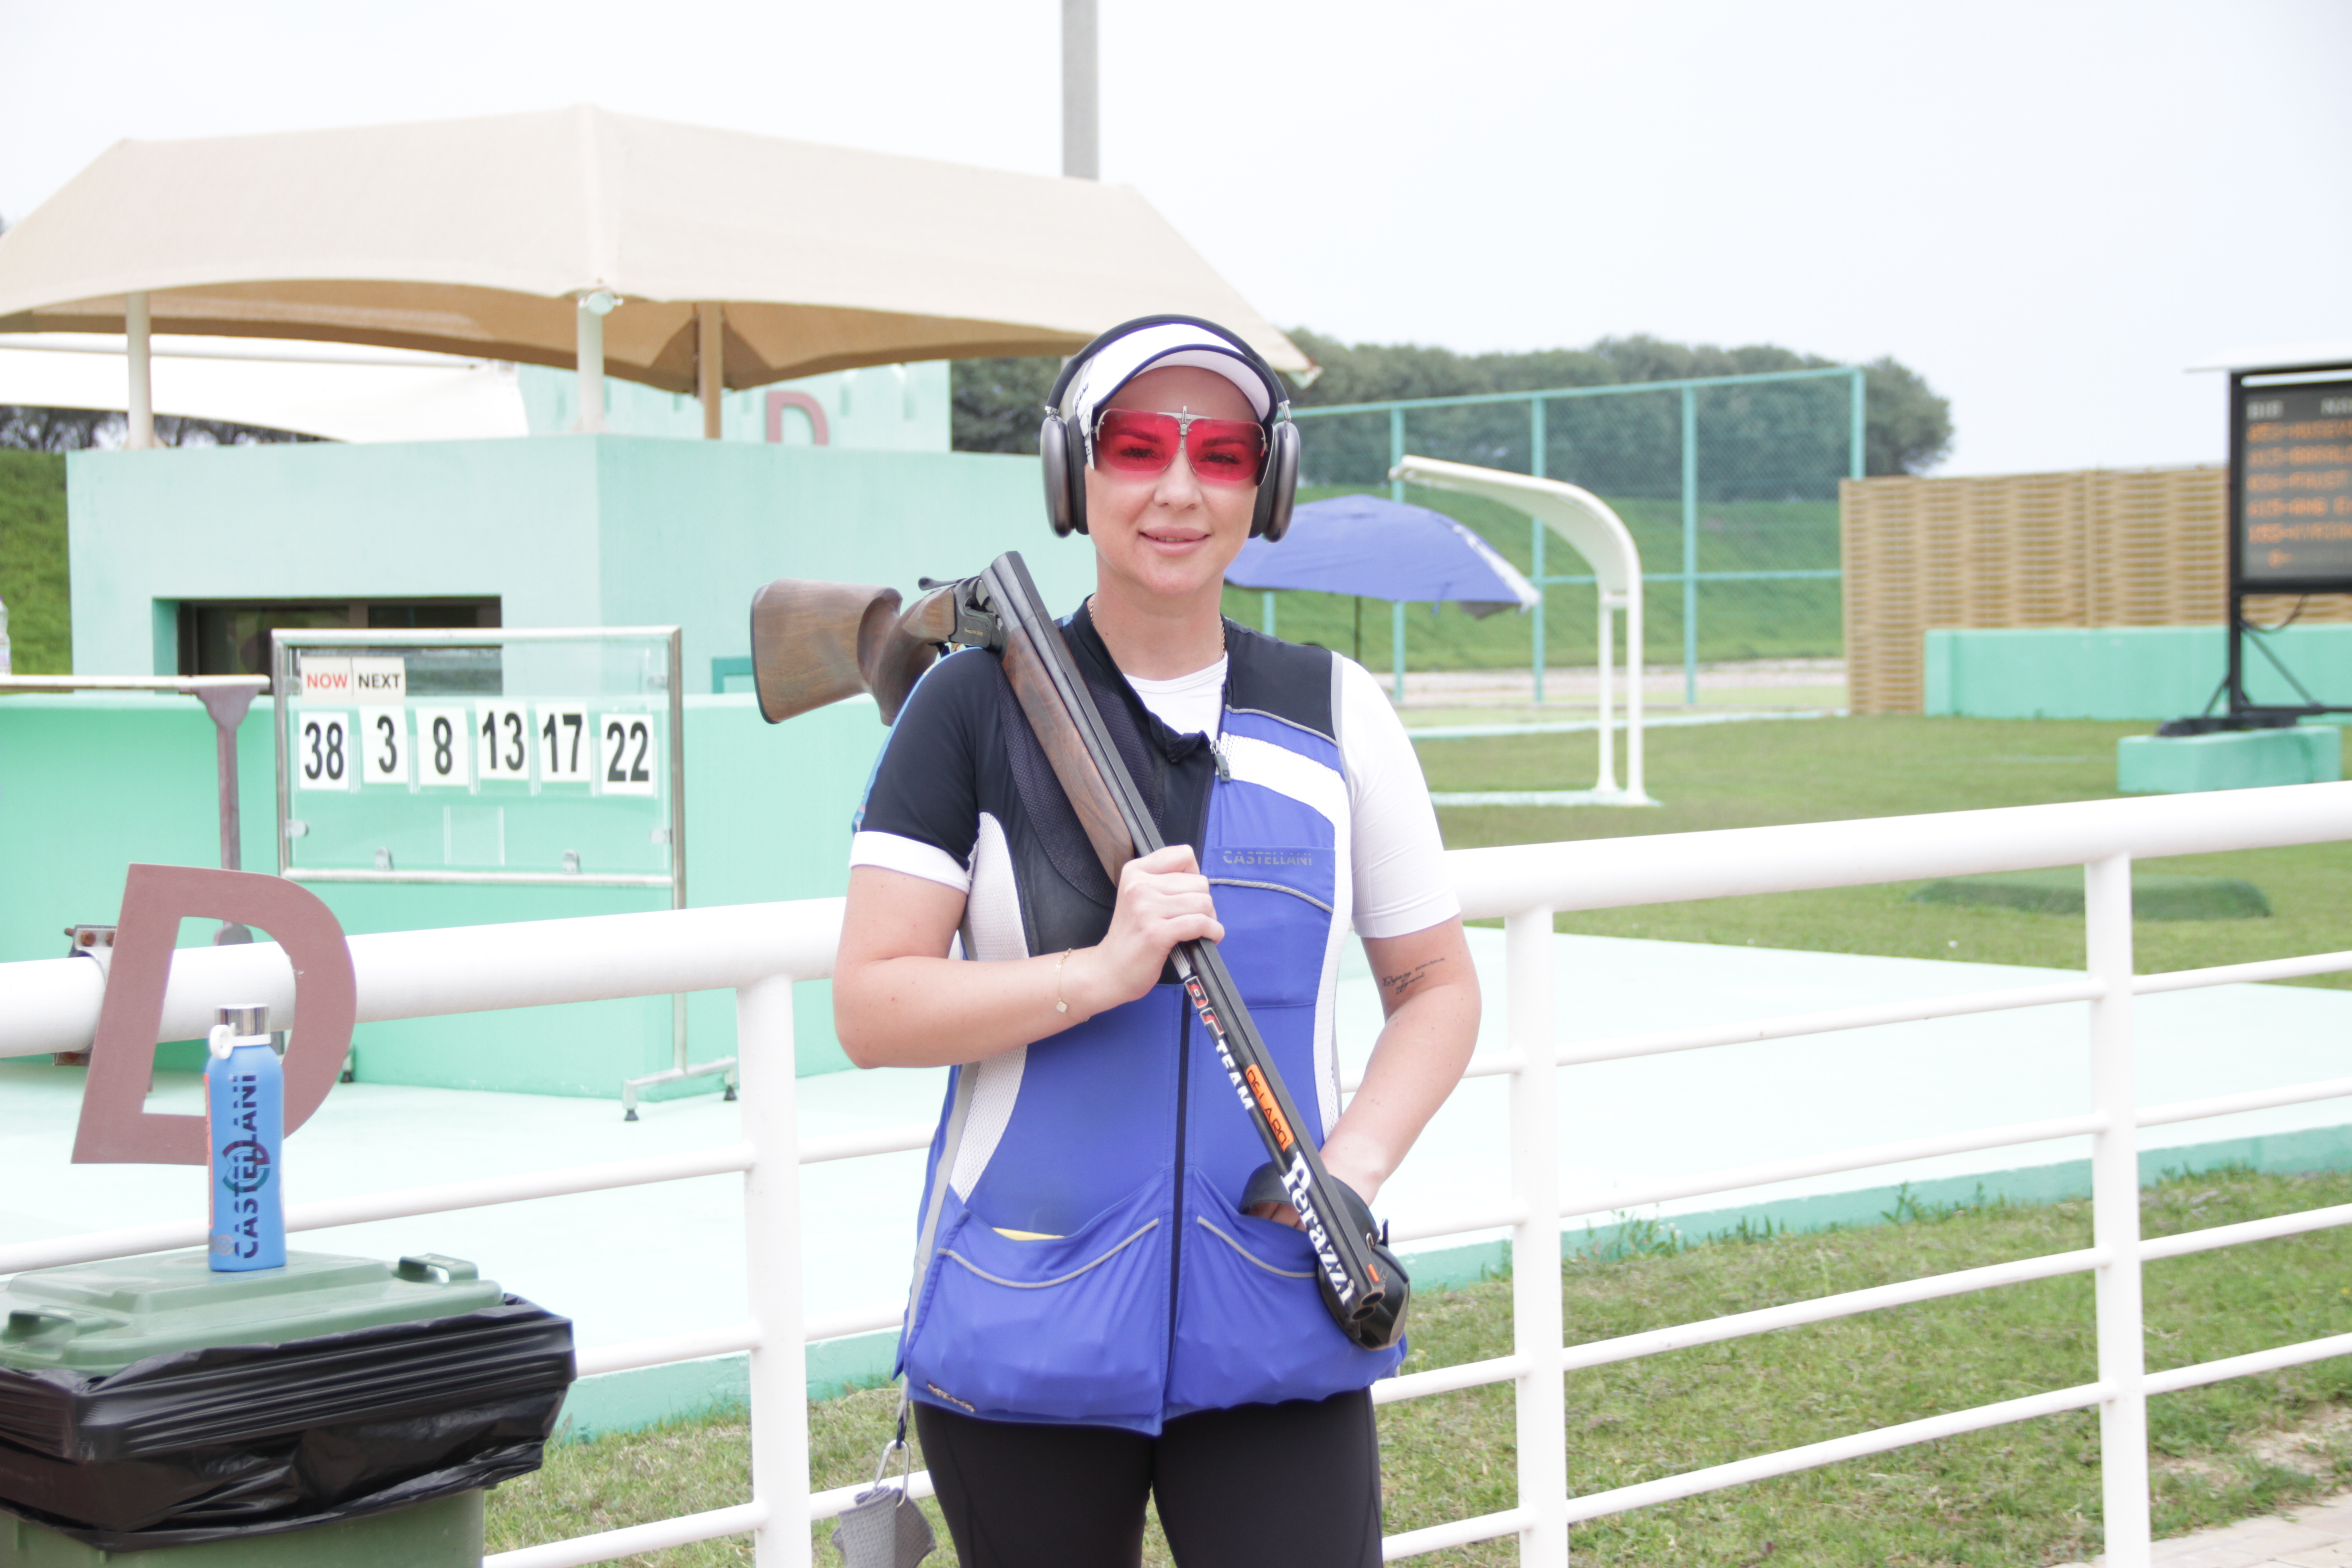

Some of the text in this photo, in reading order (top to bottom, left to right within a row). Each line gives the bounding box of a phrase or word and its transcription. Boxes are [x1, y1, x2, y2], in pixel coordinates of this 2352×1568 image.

[307, 673, 401, 689] NOW NEXT
[304, 711, 650, 782] 38 3 8 13 17 22
[1223, 850, 1313, 866] CASTELLANI
[71, 862, 357, 1166] D
[1216, 1039, 1254, 1110] TEAM
[233, 1075, 259, 1259] CASTELLANI
[1280, 1151, 1355, 1306] Perazzi
